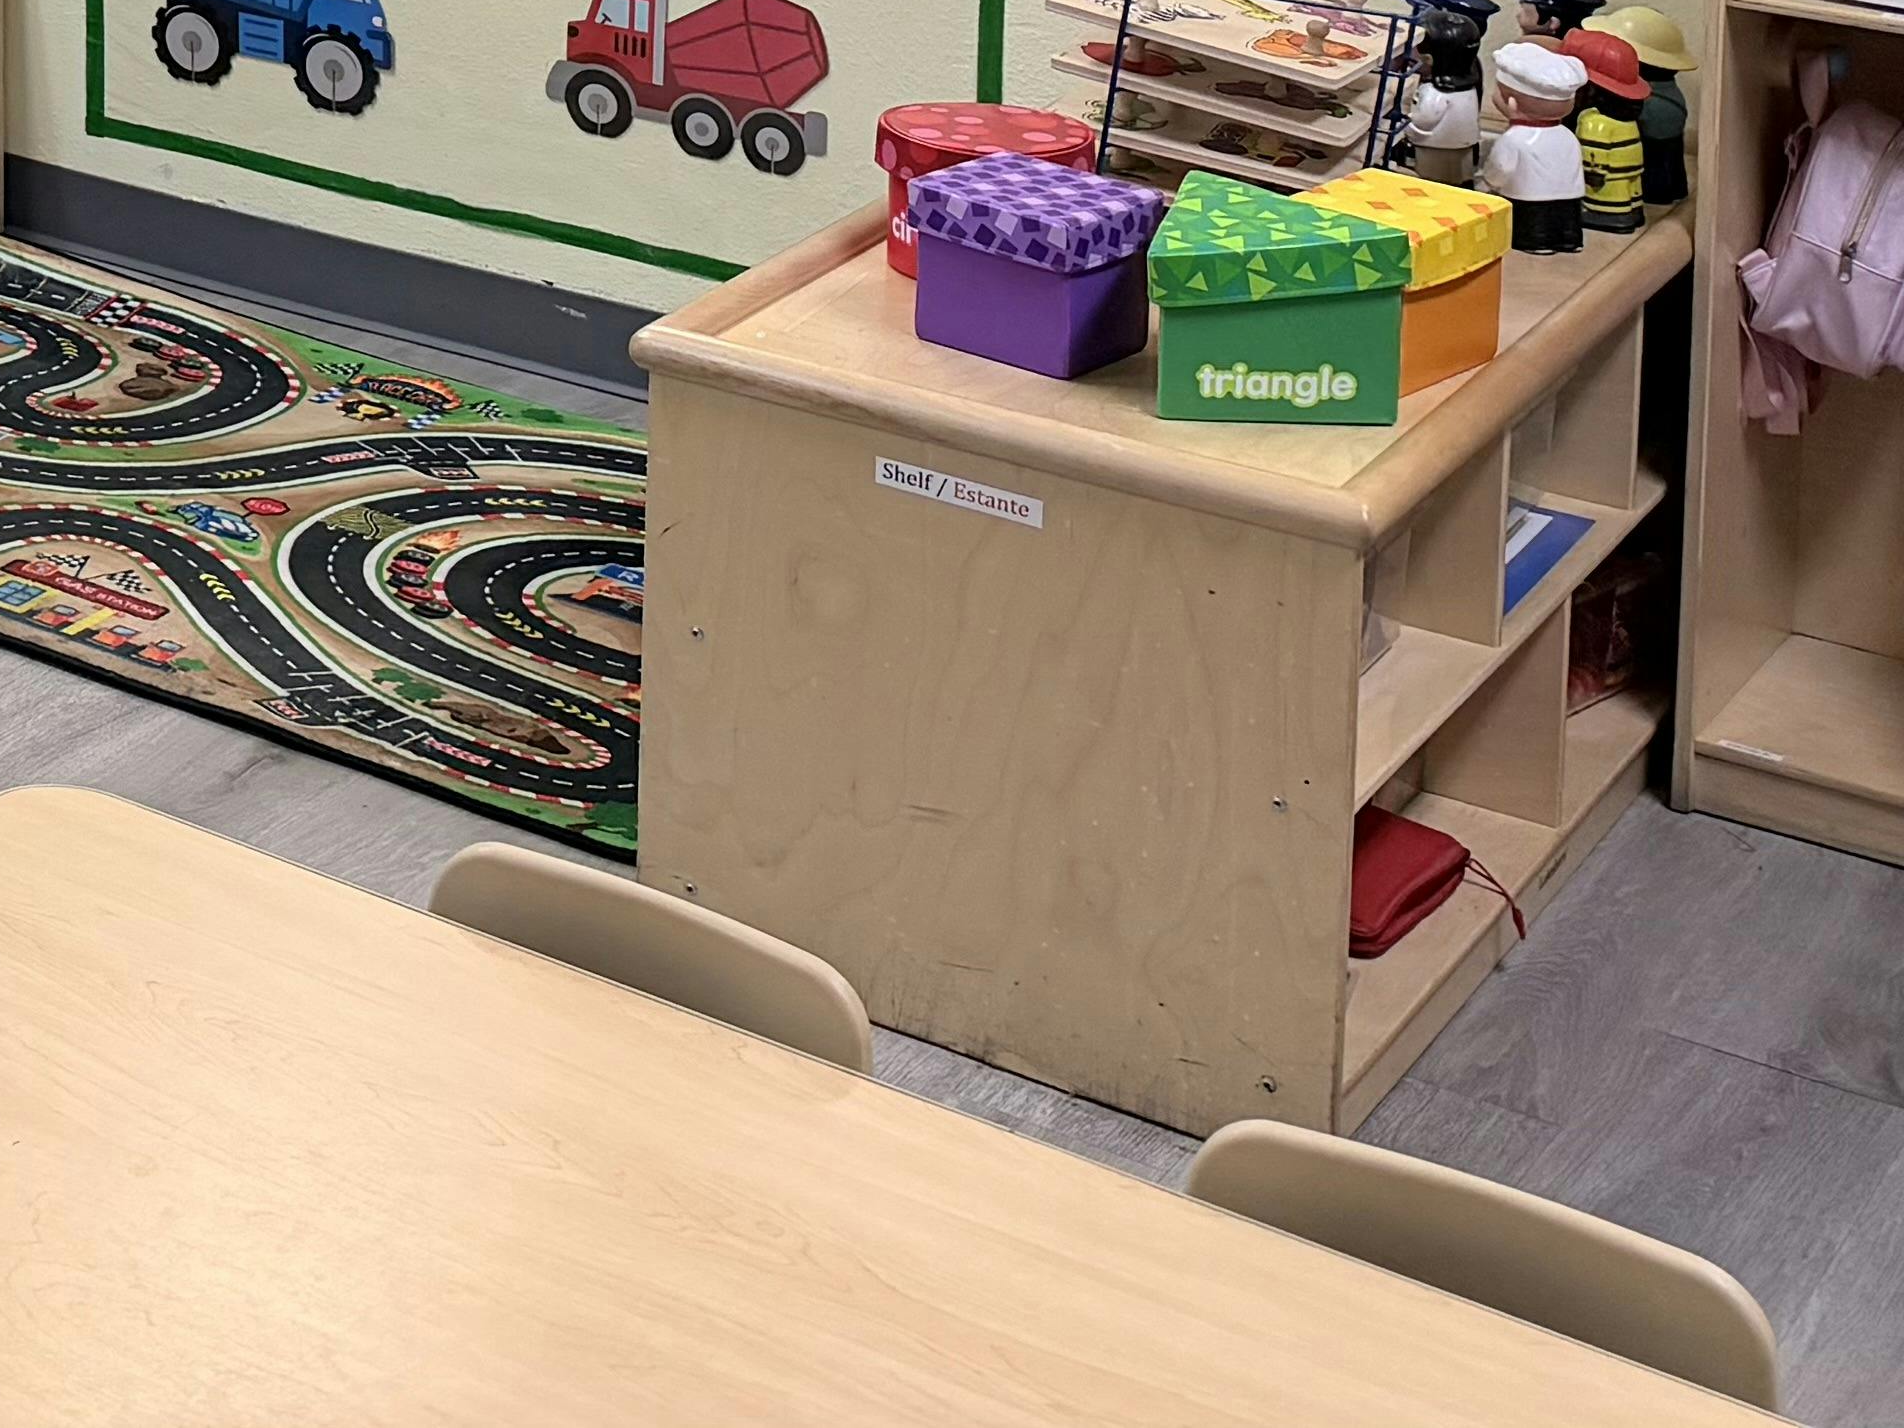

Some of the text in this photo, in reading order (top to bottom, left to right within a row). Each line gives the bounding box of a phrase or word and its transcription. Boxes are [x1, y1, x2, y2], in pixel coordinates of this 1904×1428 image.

[1196, 361, 1359, 409] triangle
[882, 461, 1030, 518] Shelf / Estante
[54, 575, 159, 617] GAS STATION
